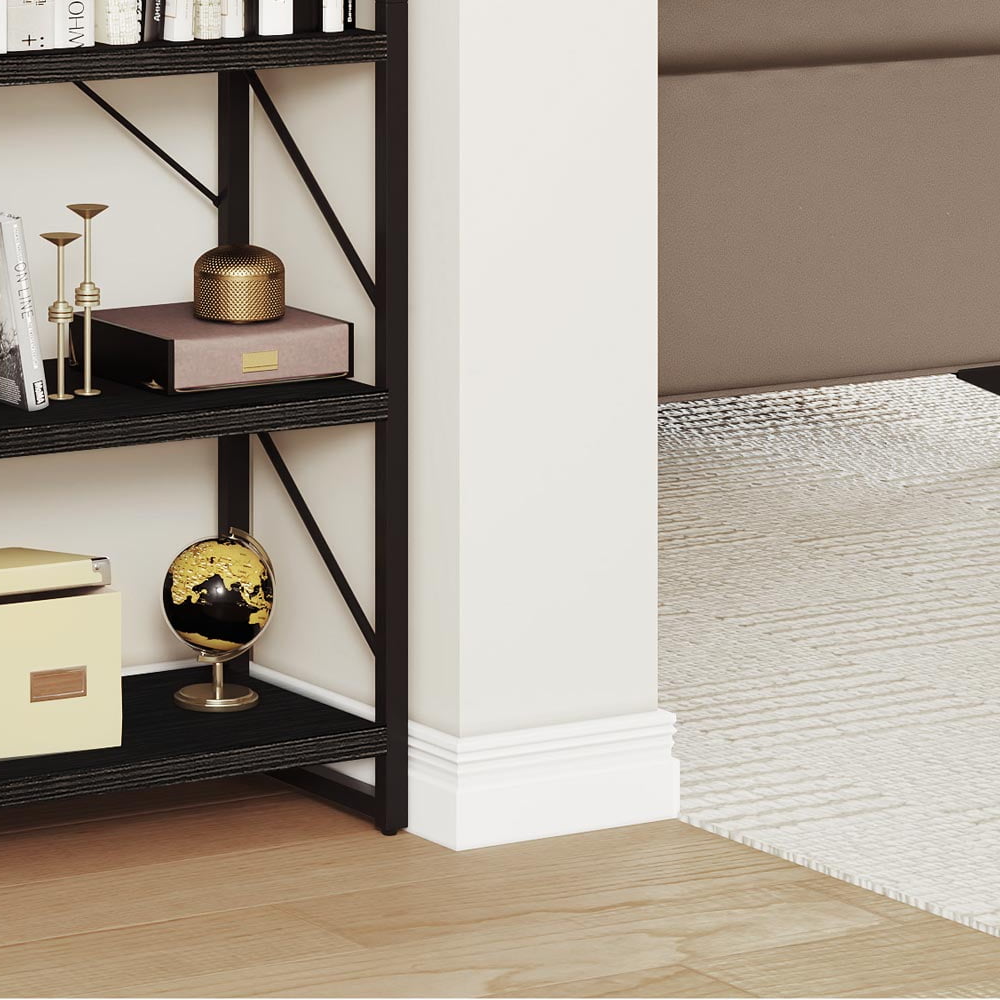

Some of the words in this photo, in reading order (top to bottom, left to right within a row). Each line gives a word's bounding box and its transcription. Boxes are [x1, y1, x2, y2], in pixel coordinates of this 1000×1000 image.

[68, 1, 85, 48] WHO
[14, 262, 29, 283] ON
[18, 287, 34, 319] LINE
